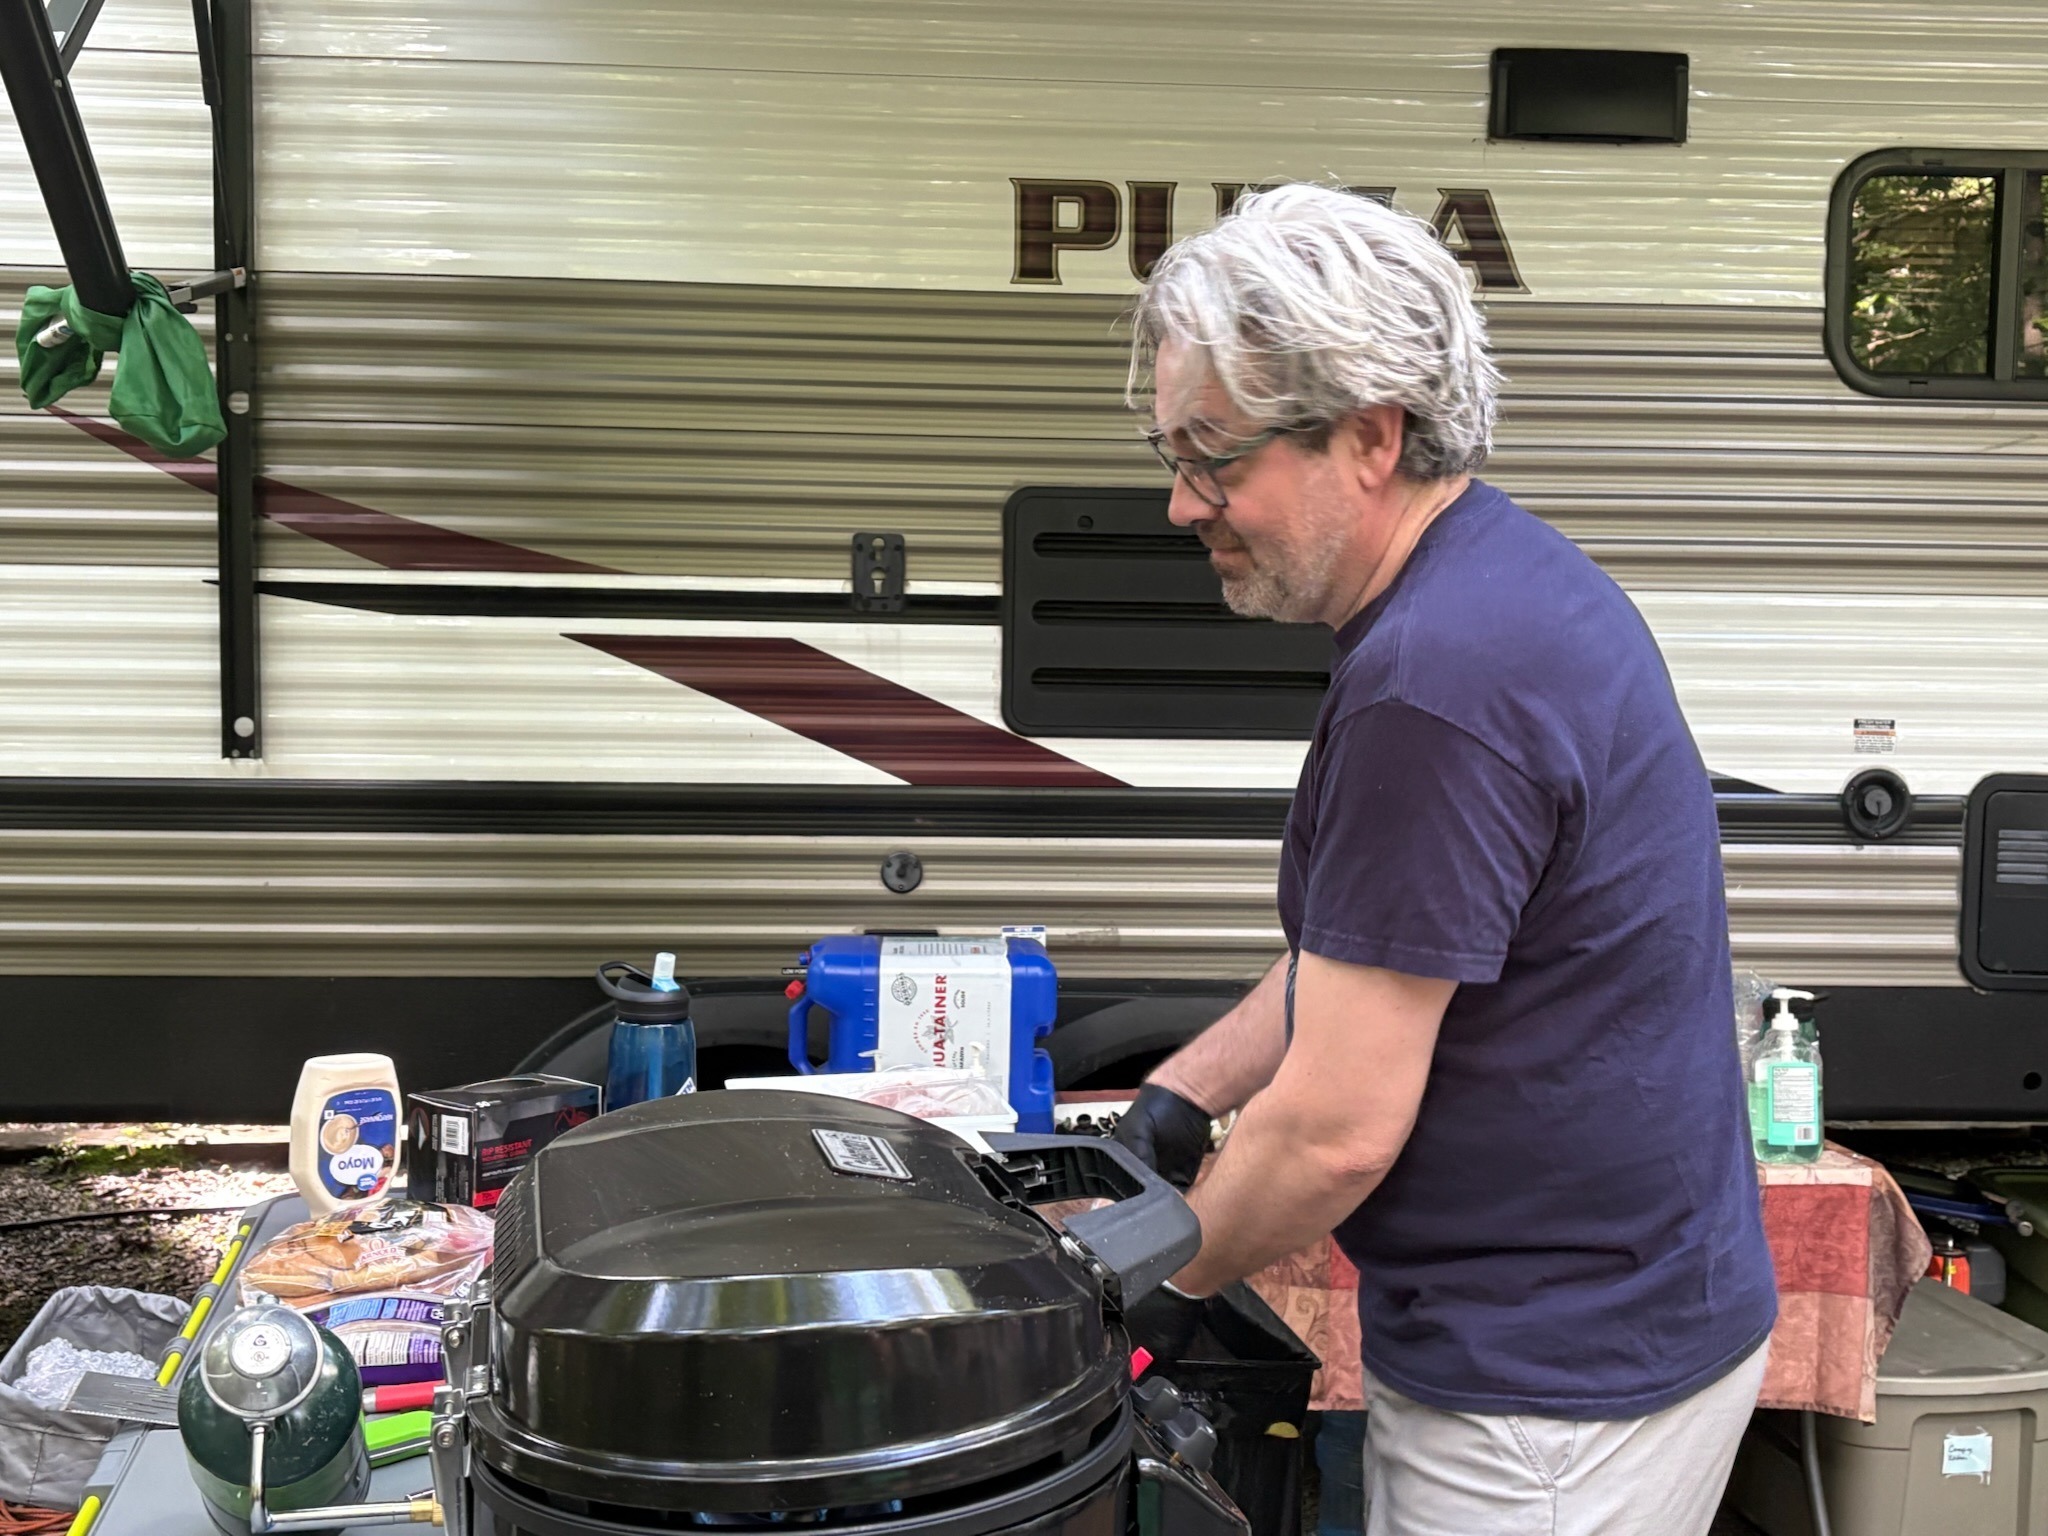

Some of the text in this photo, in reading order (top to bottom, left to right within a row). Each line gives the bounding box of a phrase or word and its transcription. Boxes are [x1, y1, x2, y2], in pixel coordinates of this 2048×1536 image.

[1008, 177, 1531, 294] PUA
[338, 1157, 374, 1170] Mayo
[359, 1246, 398, 1263] ARNOLD
